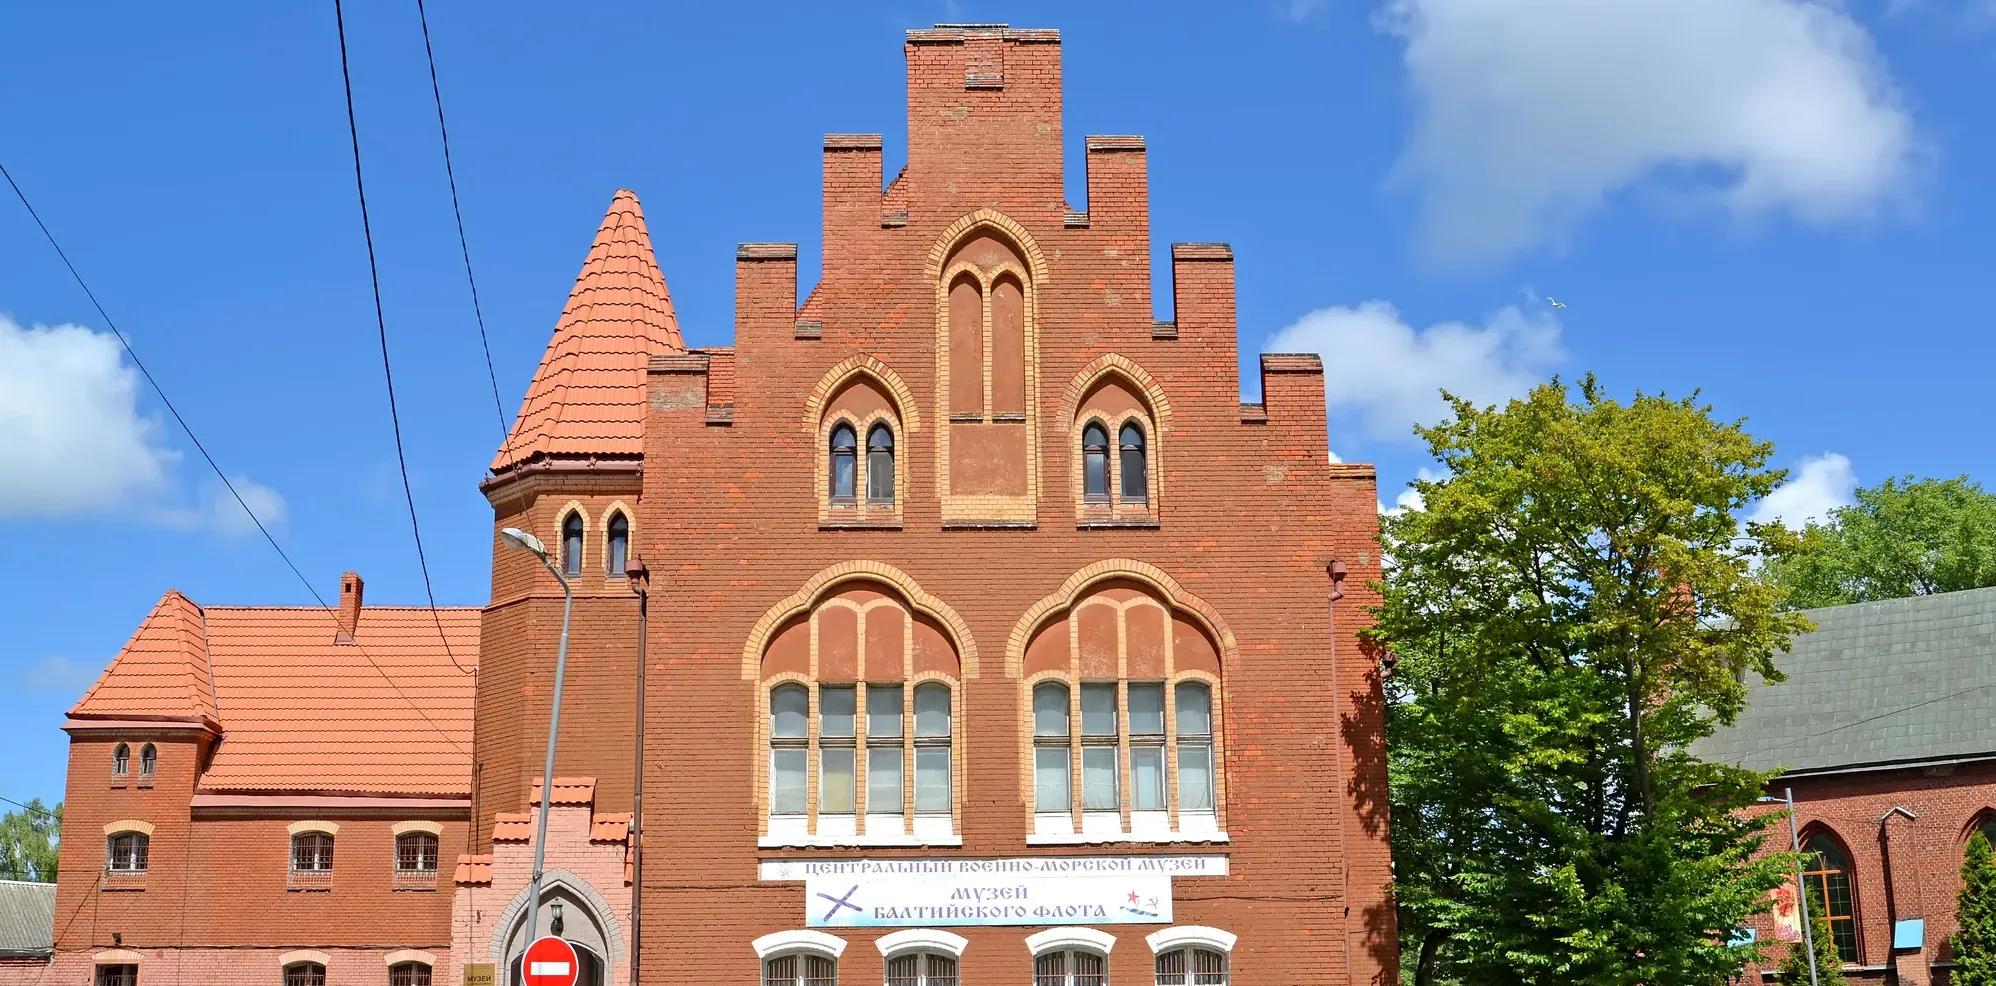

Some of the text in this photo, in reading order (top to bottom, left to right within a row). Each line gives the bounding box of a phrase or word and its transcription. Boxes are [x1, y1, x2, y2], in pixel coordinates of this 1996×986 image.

[950, 885, 1028, 902] МУЗЕЙ
[873, 904, 1107, 919] БАЛТИЙСКОГО ФЛОТА
